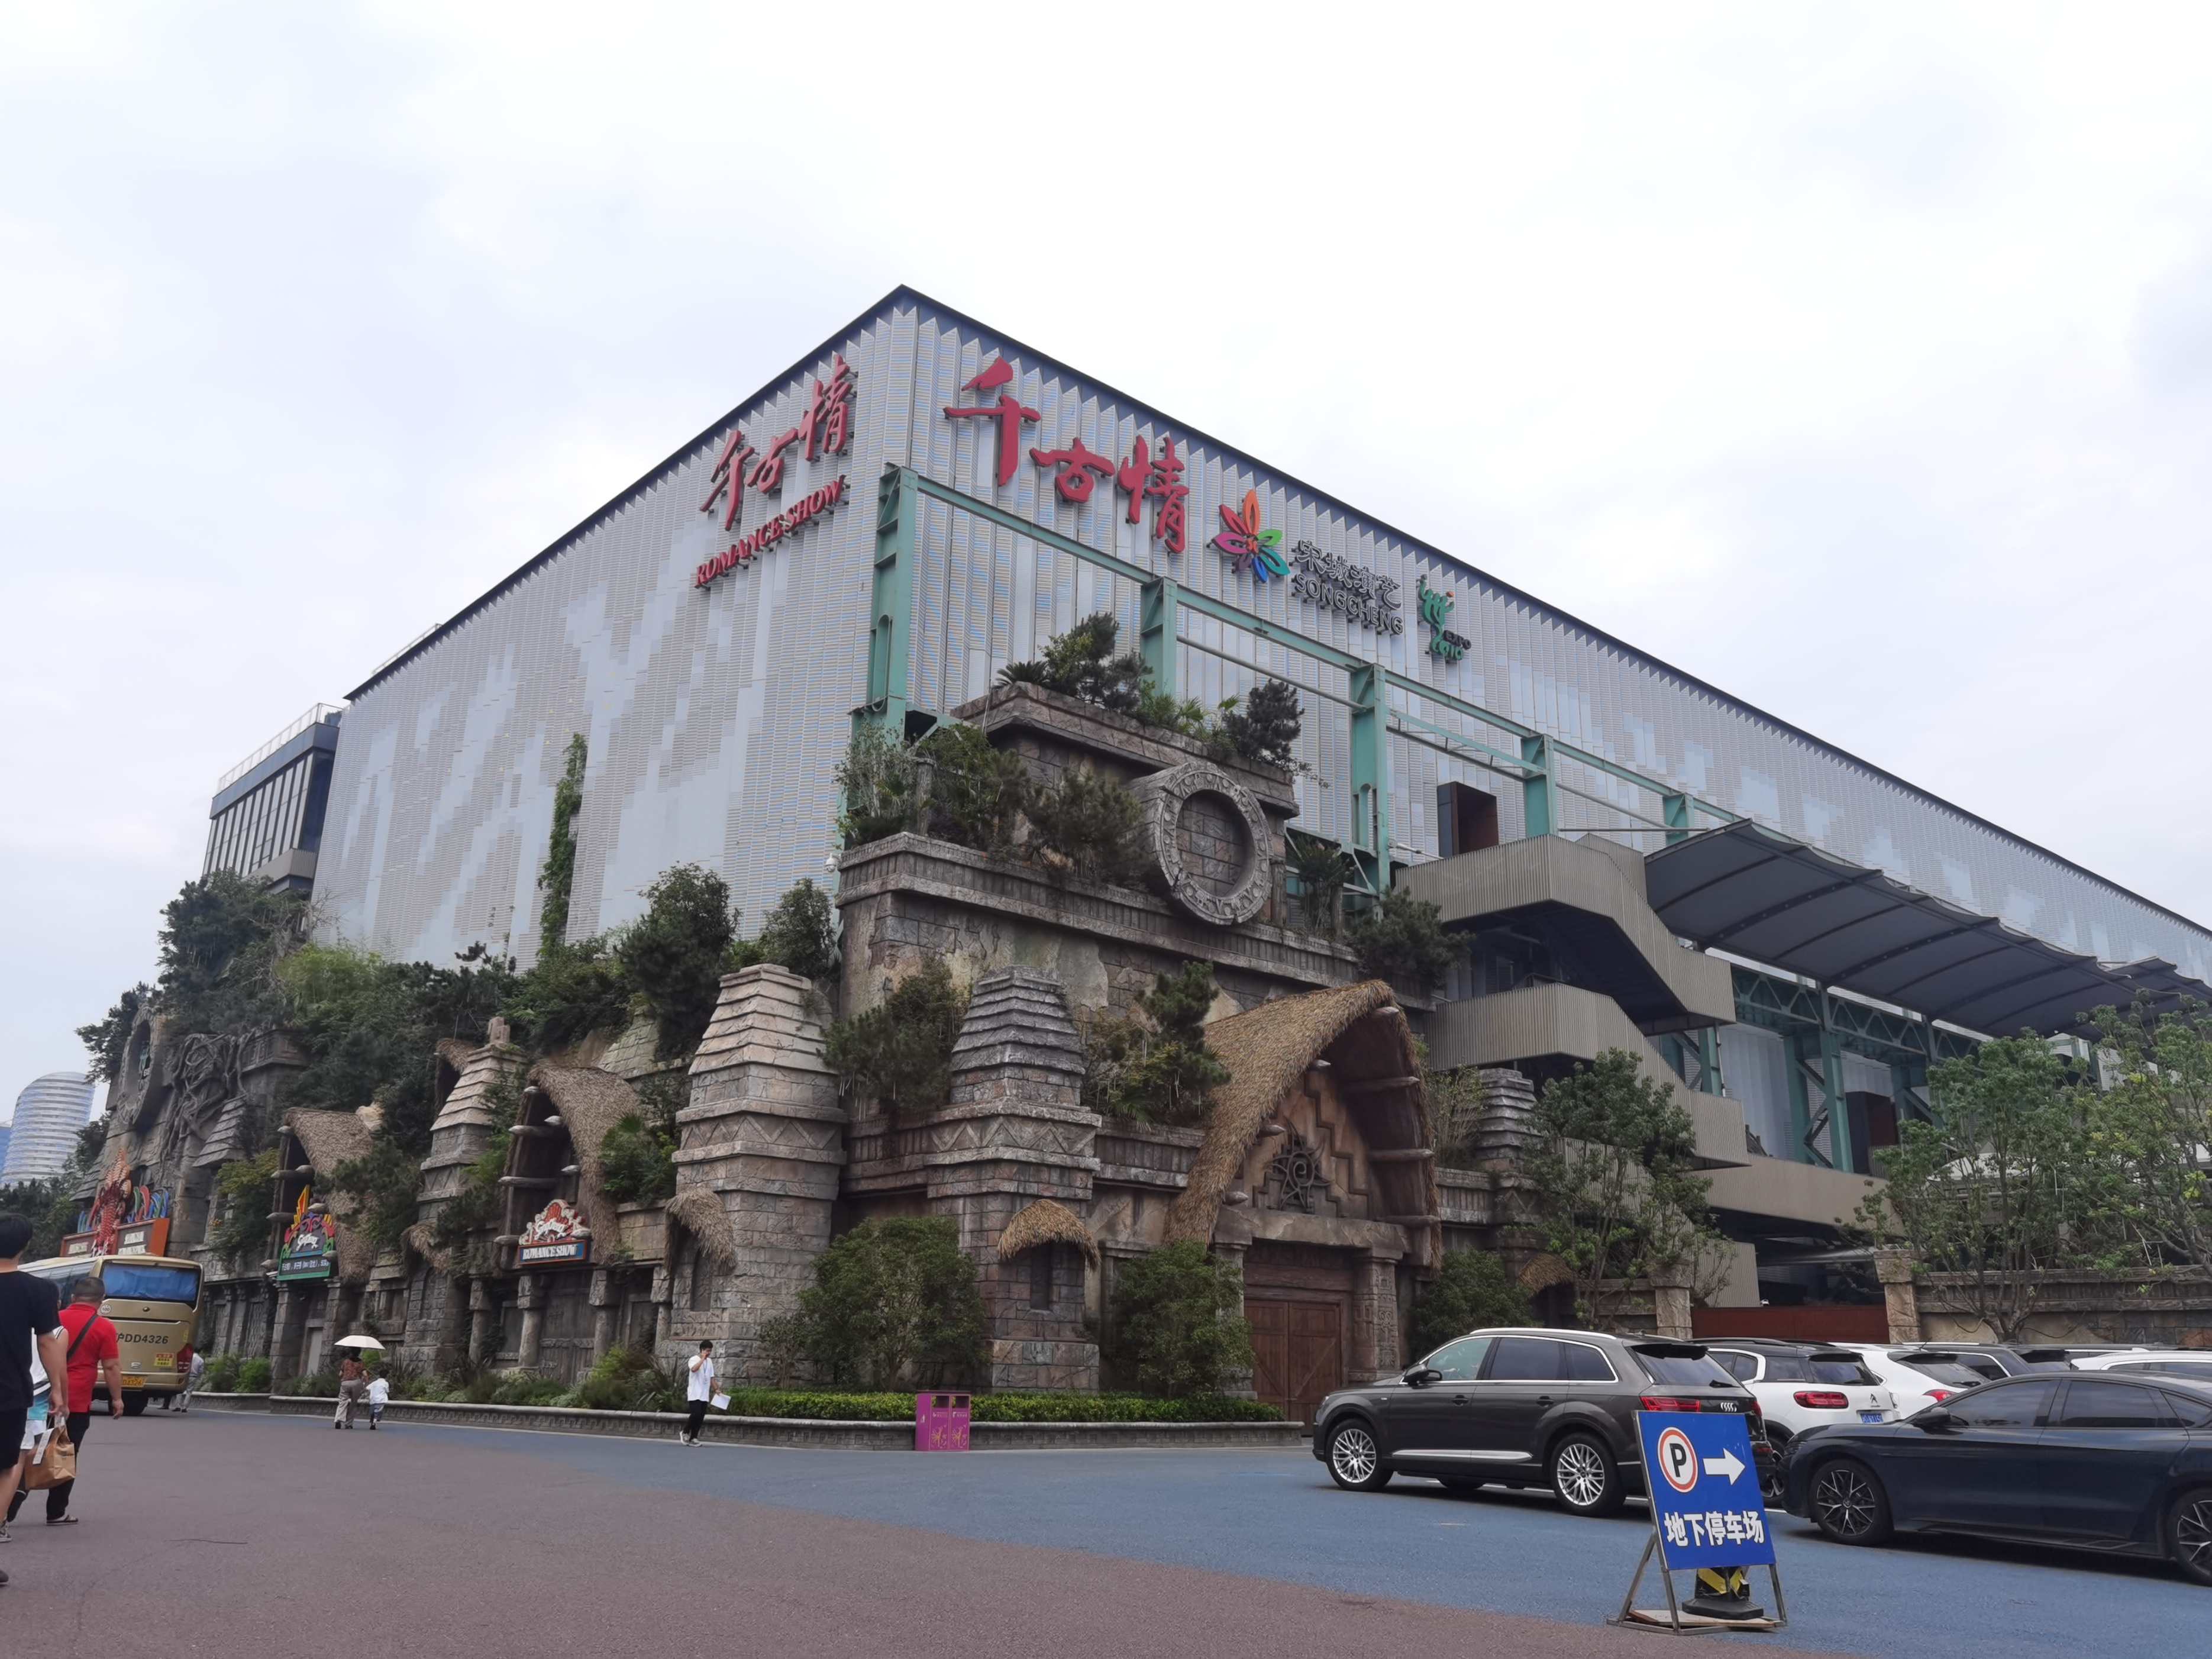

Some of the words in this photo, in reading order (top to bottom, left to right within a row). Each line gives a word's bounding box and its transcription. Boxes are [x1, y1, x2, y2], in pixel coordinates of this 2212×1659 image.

[700, 353, 852, 531] 千古情
[943, 356, 1189, 553] 千古情
[694, 514, 784, 589] ROMANCE
[784, 475, 847, 532] SHOW
[1294, 540, 1402, 611] 宋城演艺
[1294, 573, 1404, 635] SONGCHENG
[1443, 630, 1471, 650] EXPO
[522, 1245, 556, 1260] ROMANCE
[557, 1244, 579, 1257] SHOW
[1669, 1442, 1687, 1478] P
[1664, 1510, 1764, 1547] 地下停车场
